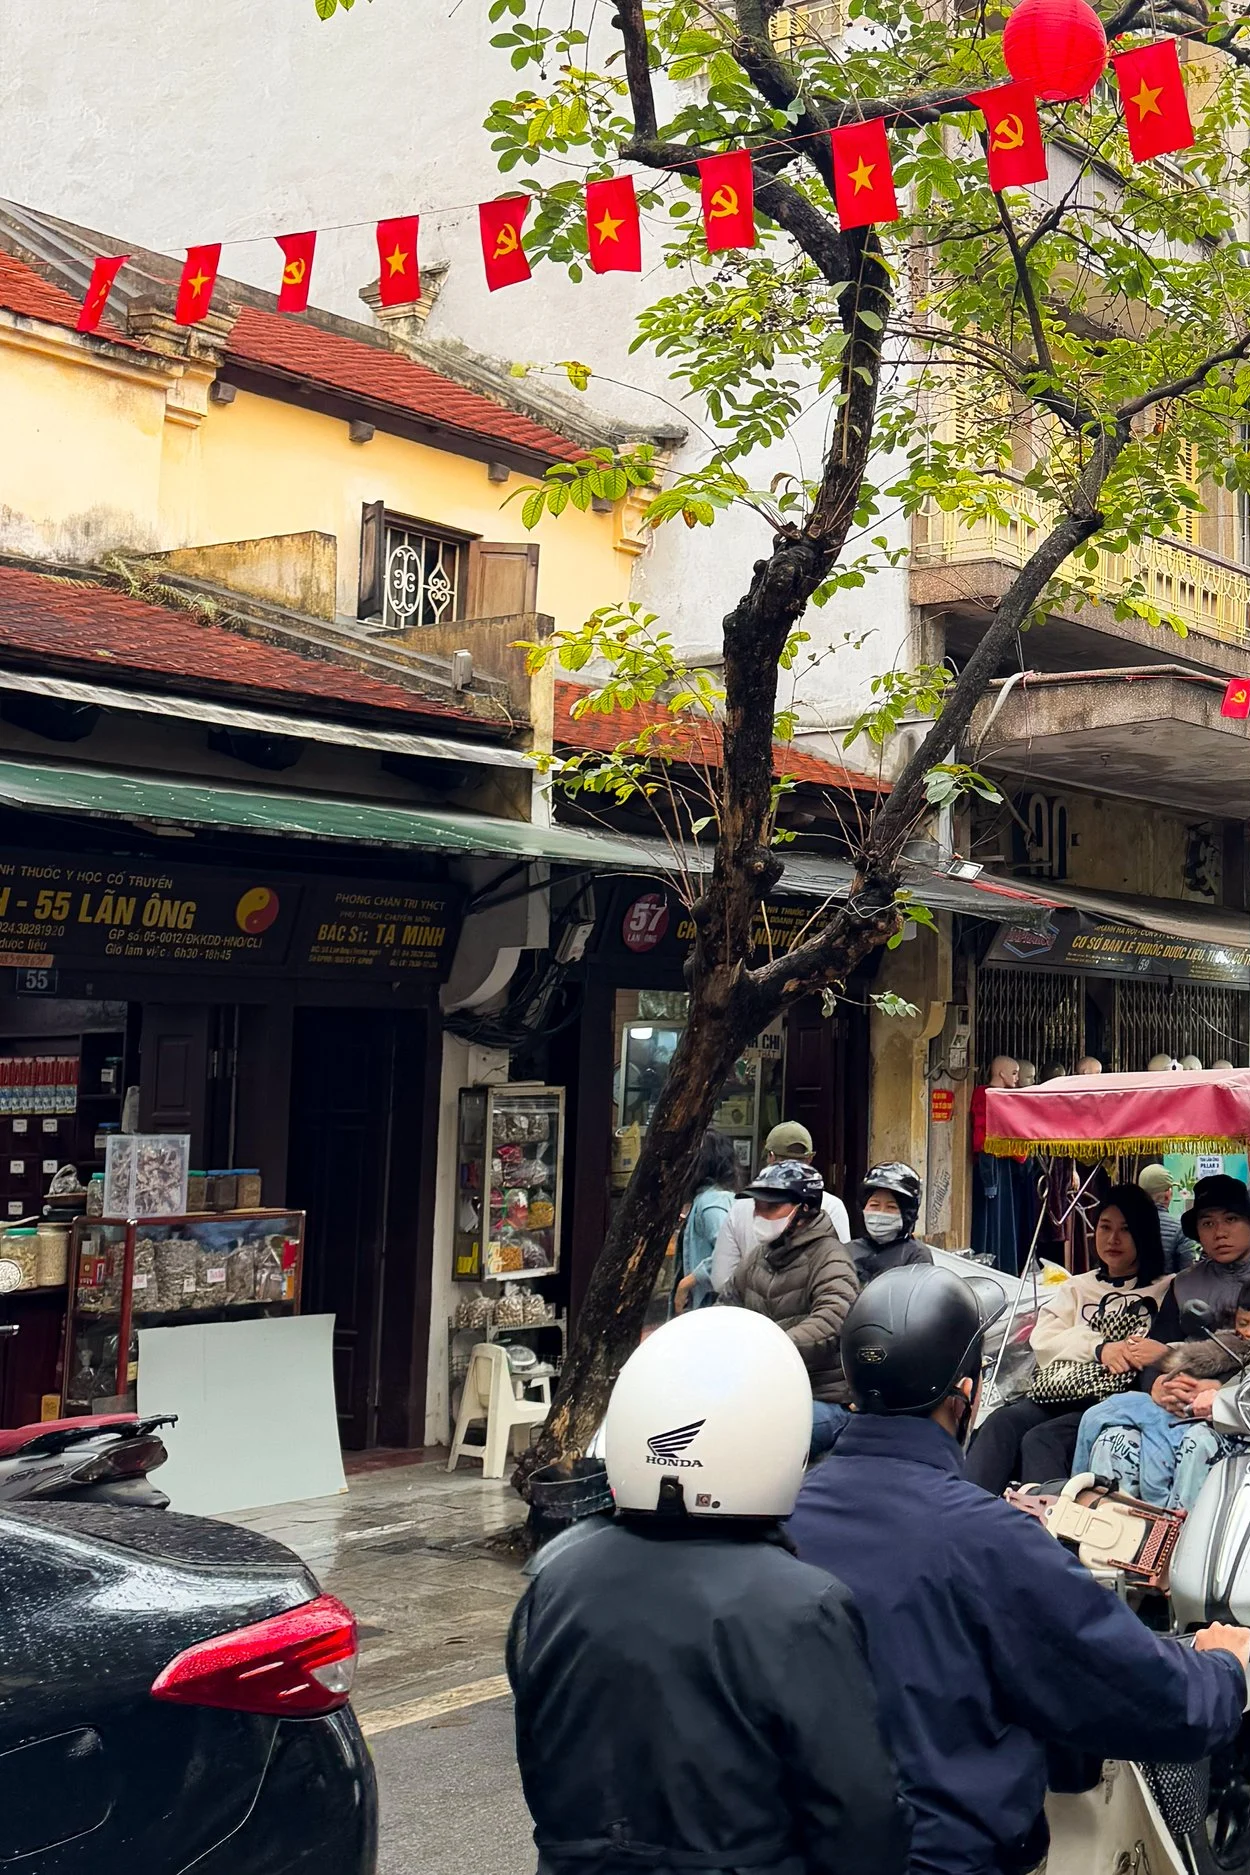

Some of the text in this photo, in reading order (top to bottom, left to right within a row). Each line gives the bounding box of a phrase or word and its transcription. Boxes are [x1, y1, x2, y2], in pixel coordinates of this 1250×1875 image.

[66, 869, 74, 881] Y
[76, 871, 102, 886] HỌC
[34, 888, 73, 922] 55
[77, 888, 137, 926] LÃN
[141, 892, 198, 930] ÔNG
[629, 903, 668, 931] 57
[108, 928, 125, 941] GP
[317, 921, 347, 942] BÁC
[376, 923, 397, 948] TẠ
[401, 924, 446, 947] MINH
[173, 946, 198, 959] 6h30
[1138, 957, 1151, 972] 59
[25, 969, 49, 989] 55
[762, 1034, 780, 1049] CHI
[645, 1455, 704, 1468] HONDA
